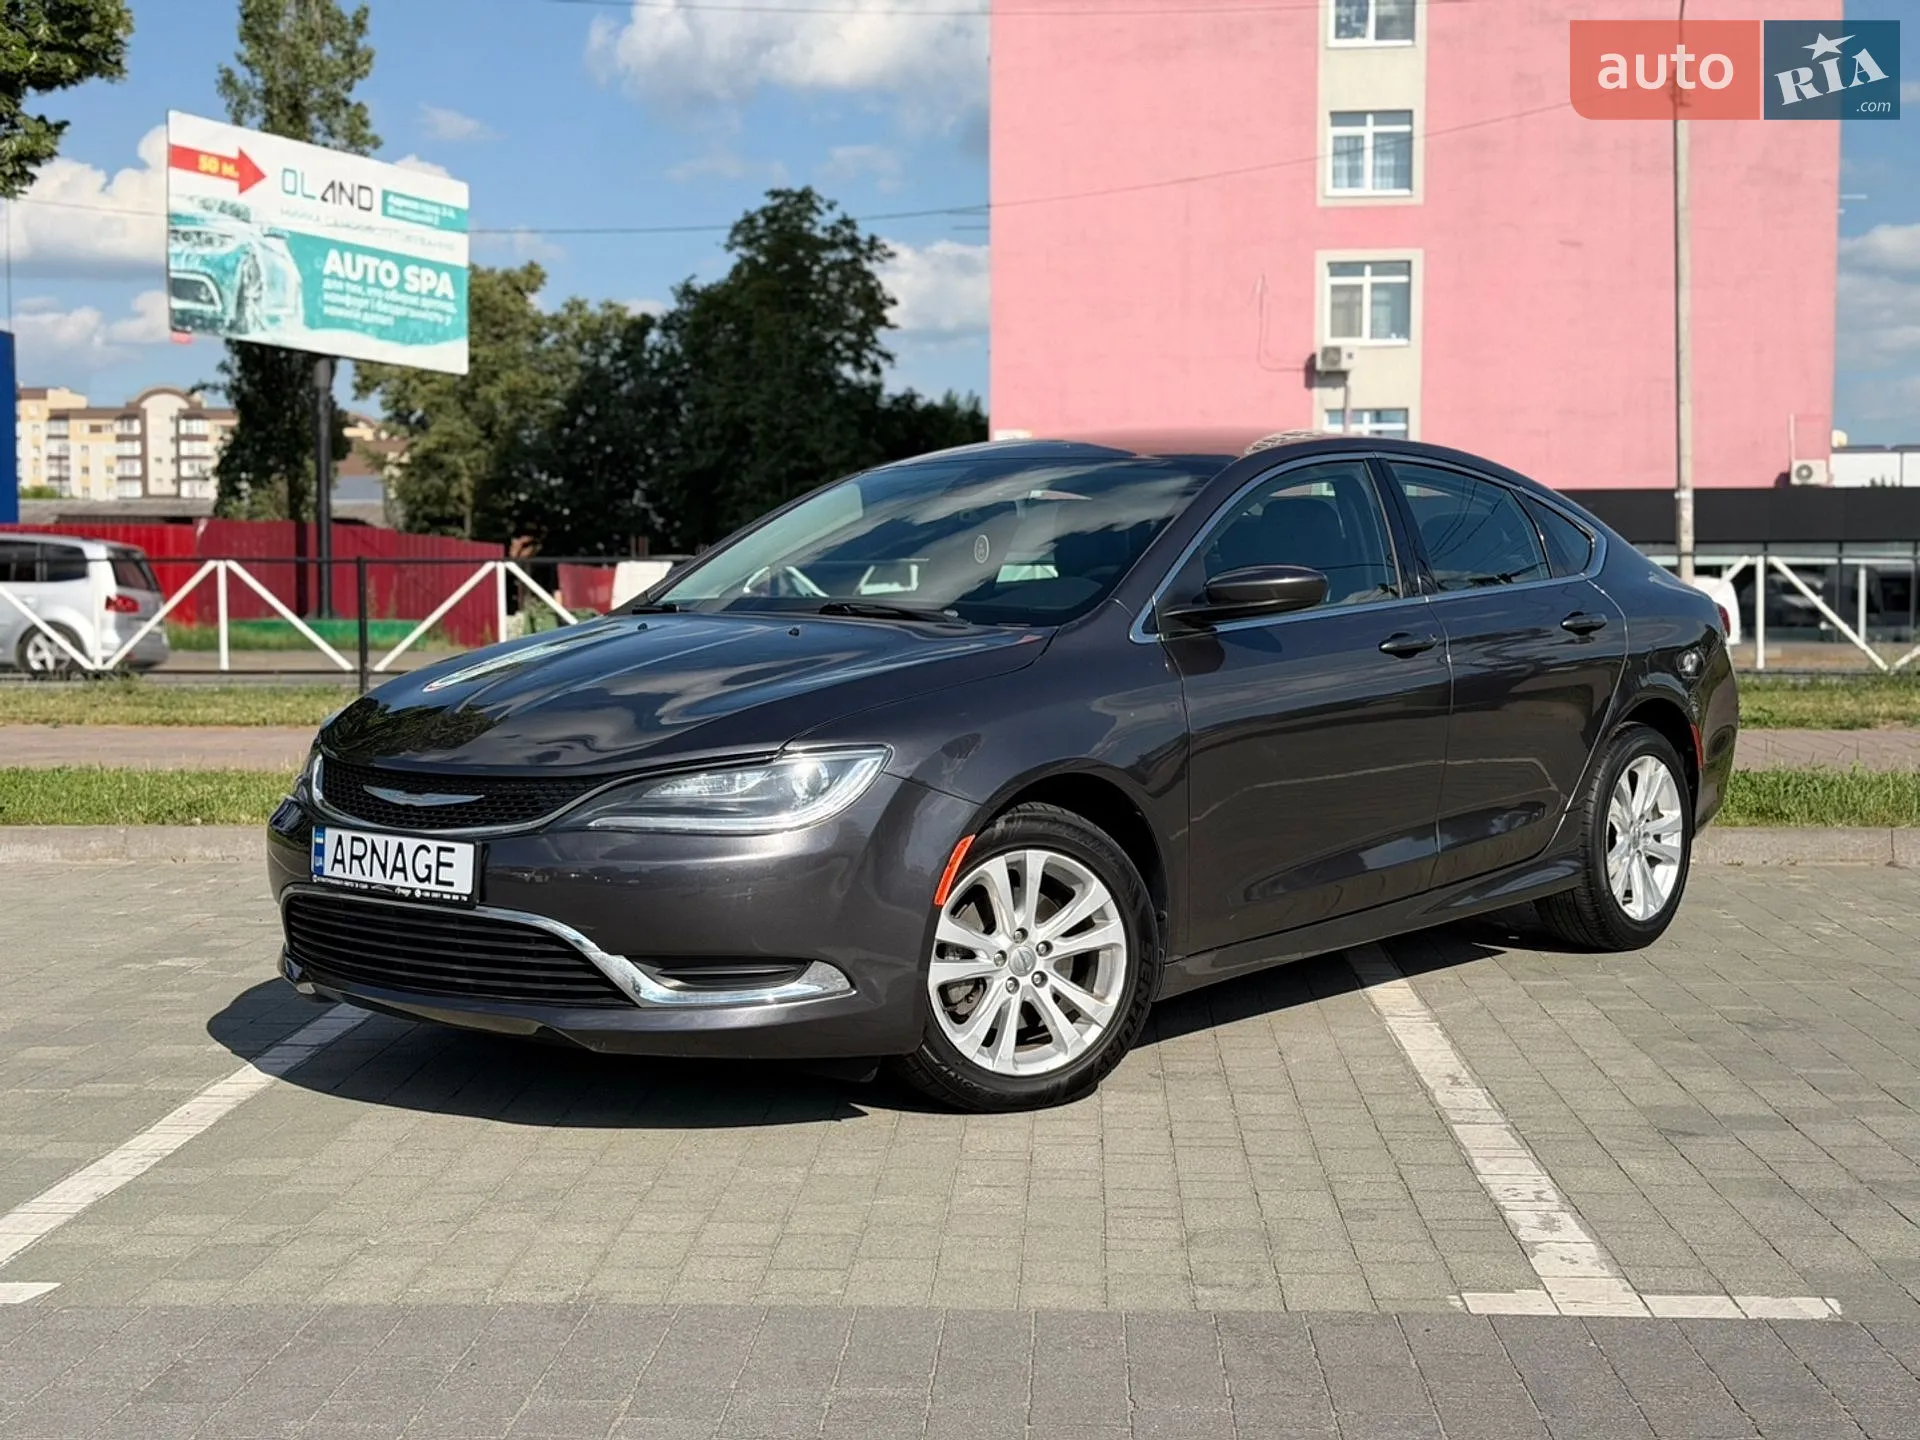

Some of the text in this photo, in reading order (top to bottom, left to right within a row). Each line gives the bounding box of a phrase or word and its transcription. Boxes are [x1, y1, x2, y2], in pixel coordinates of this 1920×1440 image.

[281, 168, 374, 212] OLAND
[323, 248, 399, 290] AUTO
[403, 264, 455, 300] SPA
[331, 834, 455, 887] ARNAGE
